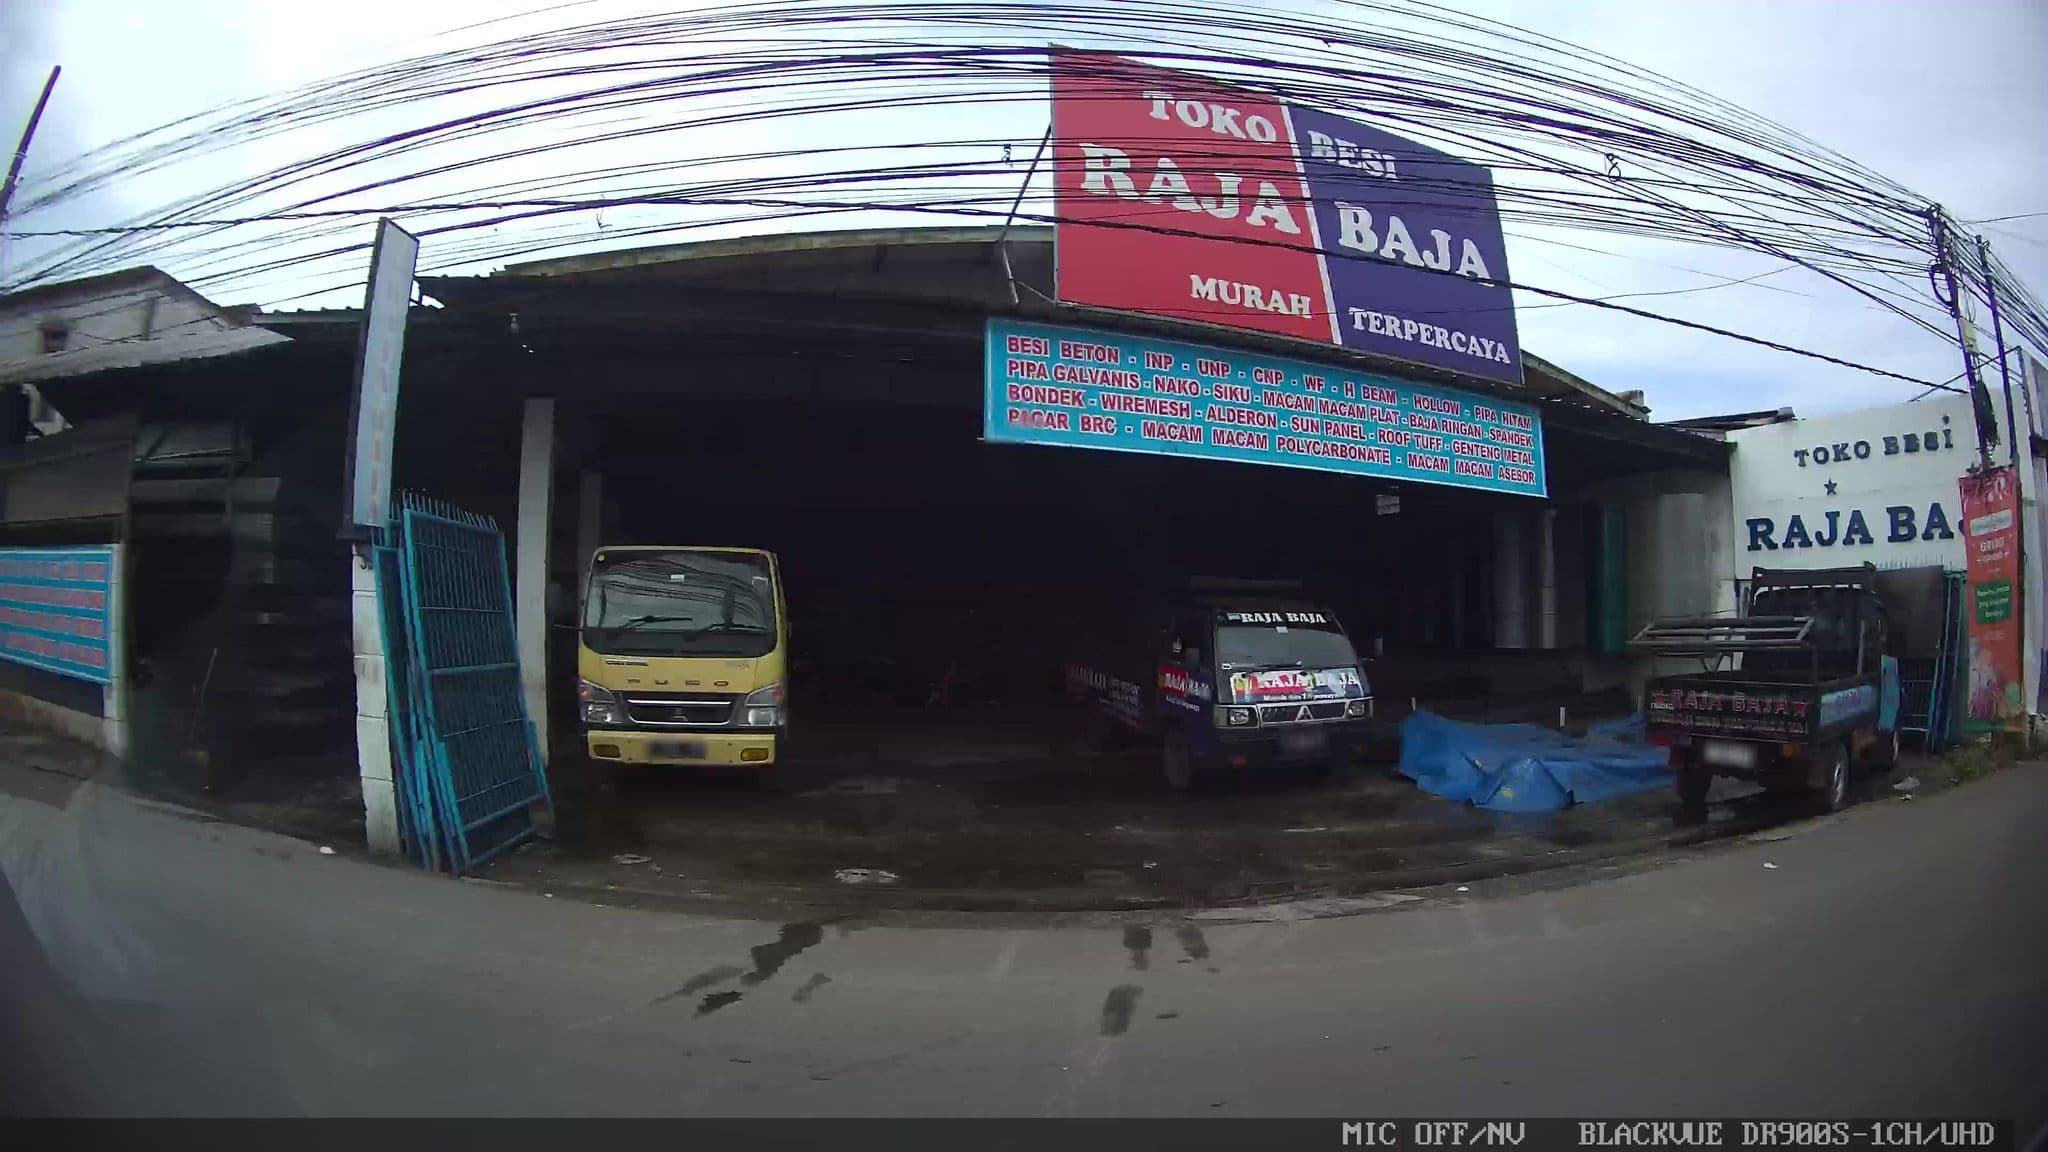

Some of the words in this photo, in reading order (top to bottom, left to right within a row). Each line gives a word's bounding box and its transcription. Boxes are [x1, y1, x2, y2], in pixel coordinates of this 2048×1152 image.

[1142, 90, 1277, 145] TOKO
[1307, 130, 1399, 182] BESI
[1078, 142, 1301, 235] RAJA
[1333, 200, 1497, 287] BAJA
[1190, 274, 1312, 319] MURAH
[1347, 306, 1512, 365] TERPERCAYA
[1007, 336, 1049, 355] BESI
[1060, 341, 1119, 364] BETON
[1145, 351, 1174, 370] INP
[1198, 358, 1230, 379] UNP
[1253, 367, 1283, 386] CNP
[1304, 374, 1325, 393] WF
[1344, 382, 1354, 398] H
[1362, 384, 1397, 404] BEAM
[1413, 395, 1460, 416] HOLLOW
[1474, 406, 1497, 422] PIPA
[1502, 412, 1532, 430] HITAM
[1007, 359, 1049, 380] PIPA
[1053, 365, 1140, 390] GALVANIS
[1154, 376, 1200, 397] NAKO
[1214, 384, 1250, 403] SIKU
[1263, 391, 1315, 412] MACAM
[1318, 397, 1366, 419] MACAM
[1370, 407, 1400, 426] PLAT
[1409, 414, 1439, 431] BAJA
[1441, 419, 1482, 438] RINGAN
[1489, 428, 1533, 448] SPANDEK
[1007, 384, 1086, 407] BONDEK
[1101, 393, 1191, 418] WIREMESH
[1206, 405, 1277, 429] ALDERON
[1291, 415, 1320, 432] SUN
[1324, 420, 1366, 441] PANEL
[1378, 429, 1410, 446] ROOF
[1413, 434, 1443, 450] TUFF
[1452, 440, 1500, 460] GENTENG
[1503, 447, 1535, 465] METAL
[1008, 408, 1069, 431] PAGAR
[1079, 415, 1118, 435] BRC
[1143, 421, 1202, 442] MACAM
[1212, 428, 1268, 450] MACAM
[1277, 436, 1390, 465] POLYCARBONATE
[1407, 453, 1449, 472] MACAM
[1455, 459, 1493, 478] MACAM
[1498, 465, 1536, 485] ASESOR
[1793, 439, 1871, 467] TOKO
[1745, 509, 1875, 552] RAJA
[1886, 502, 1965, 544] BA
[1240, 612, 1282, 623] RAJA
[1286, 612, 1327, 624] BAJA
[1733, 695, 1788, 715] BAJA
